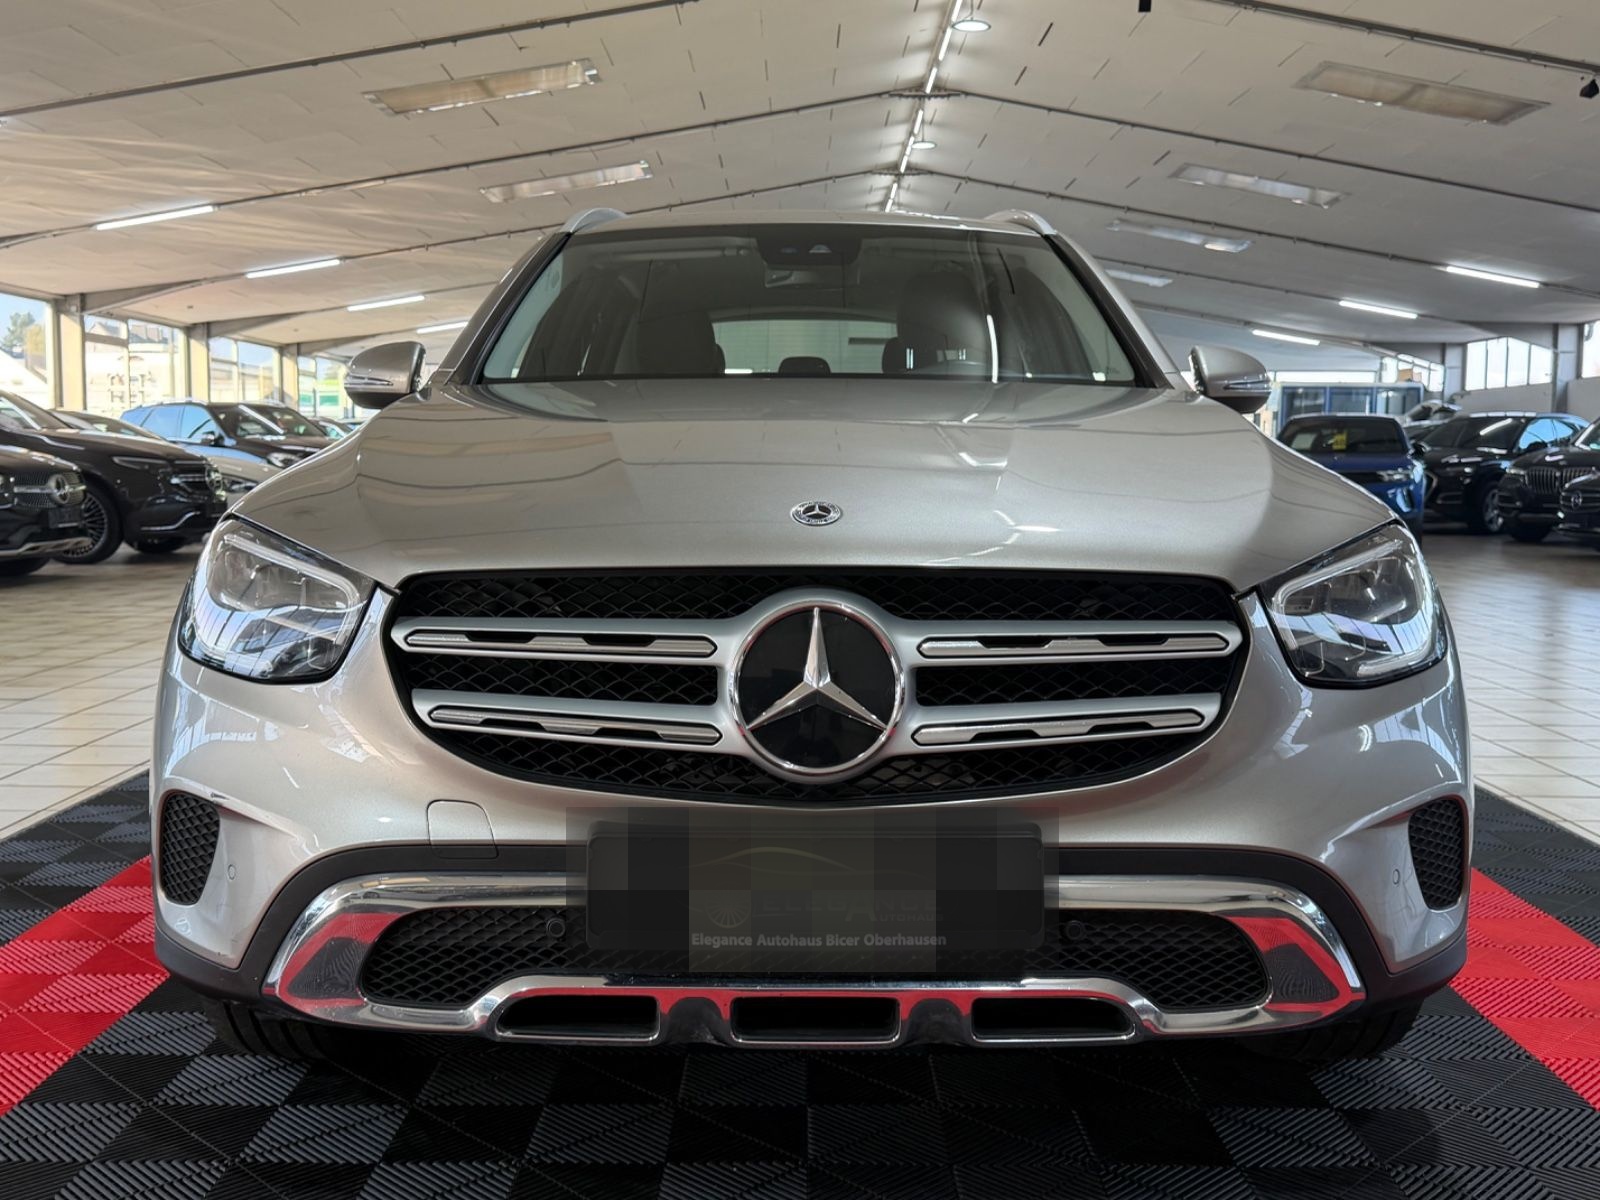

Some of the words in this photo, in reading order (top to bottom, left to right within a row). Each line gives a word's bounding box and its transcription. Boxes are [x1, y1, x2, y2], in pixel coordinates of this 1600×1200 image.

[690, 933, 754, 949] Elegance
[757, 934, 824, 948] Autohaus
[826, 933, 861, 947] Bicer
[863, 933, 948, 947] Oberhausen
